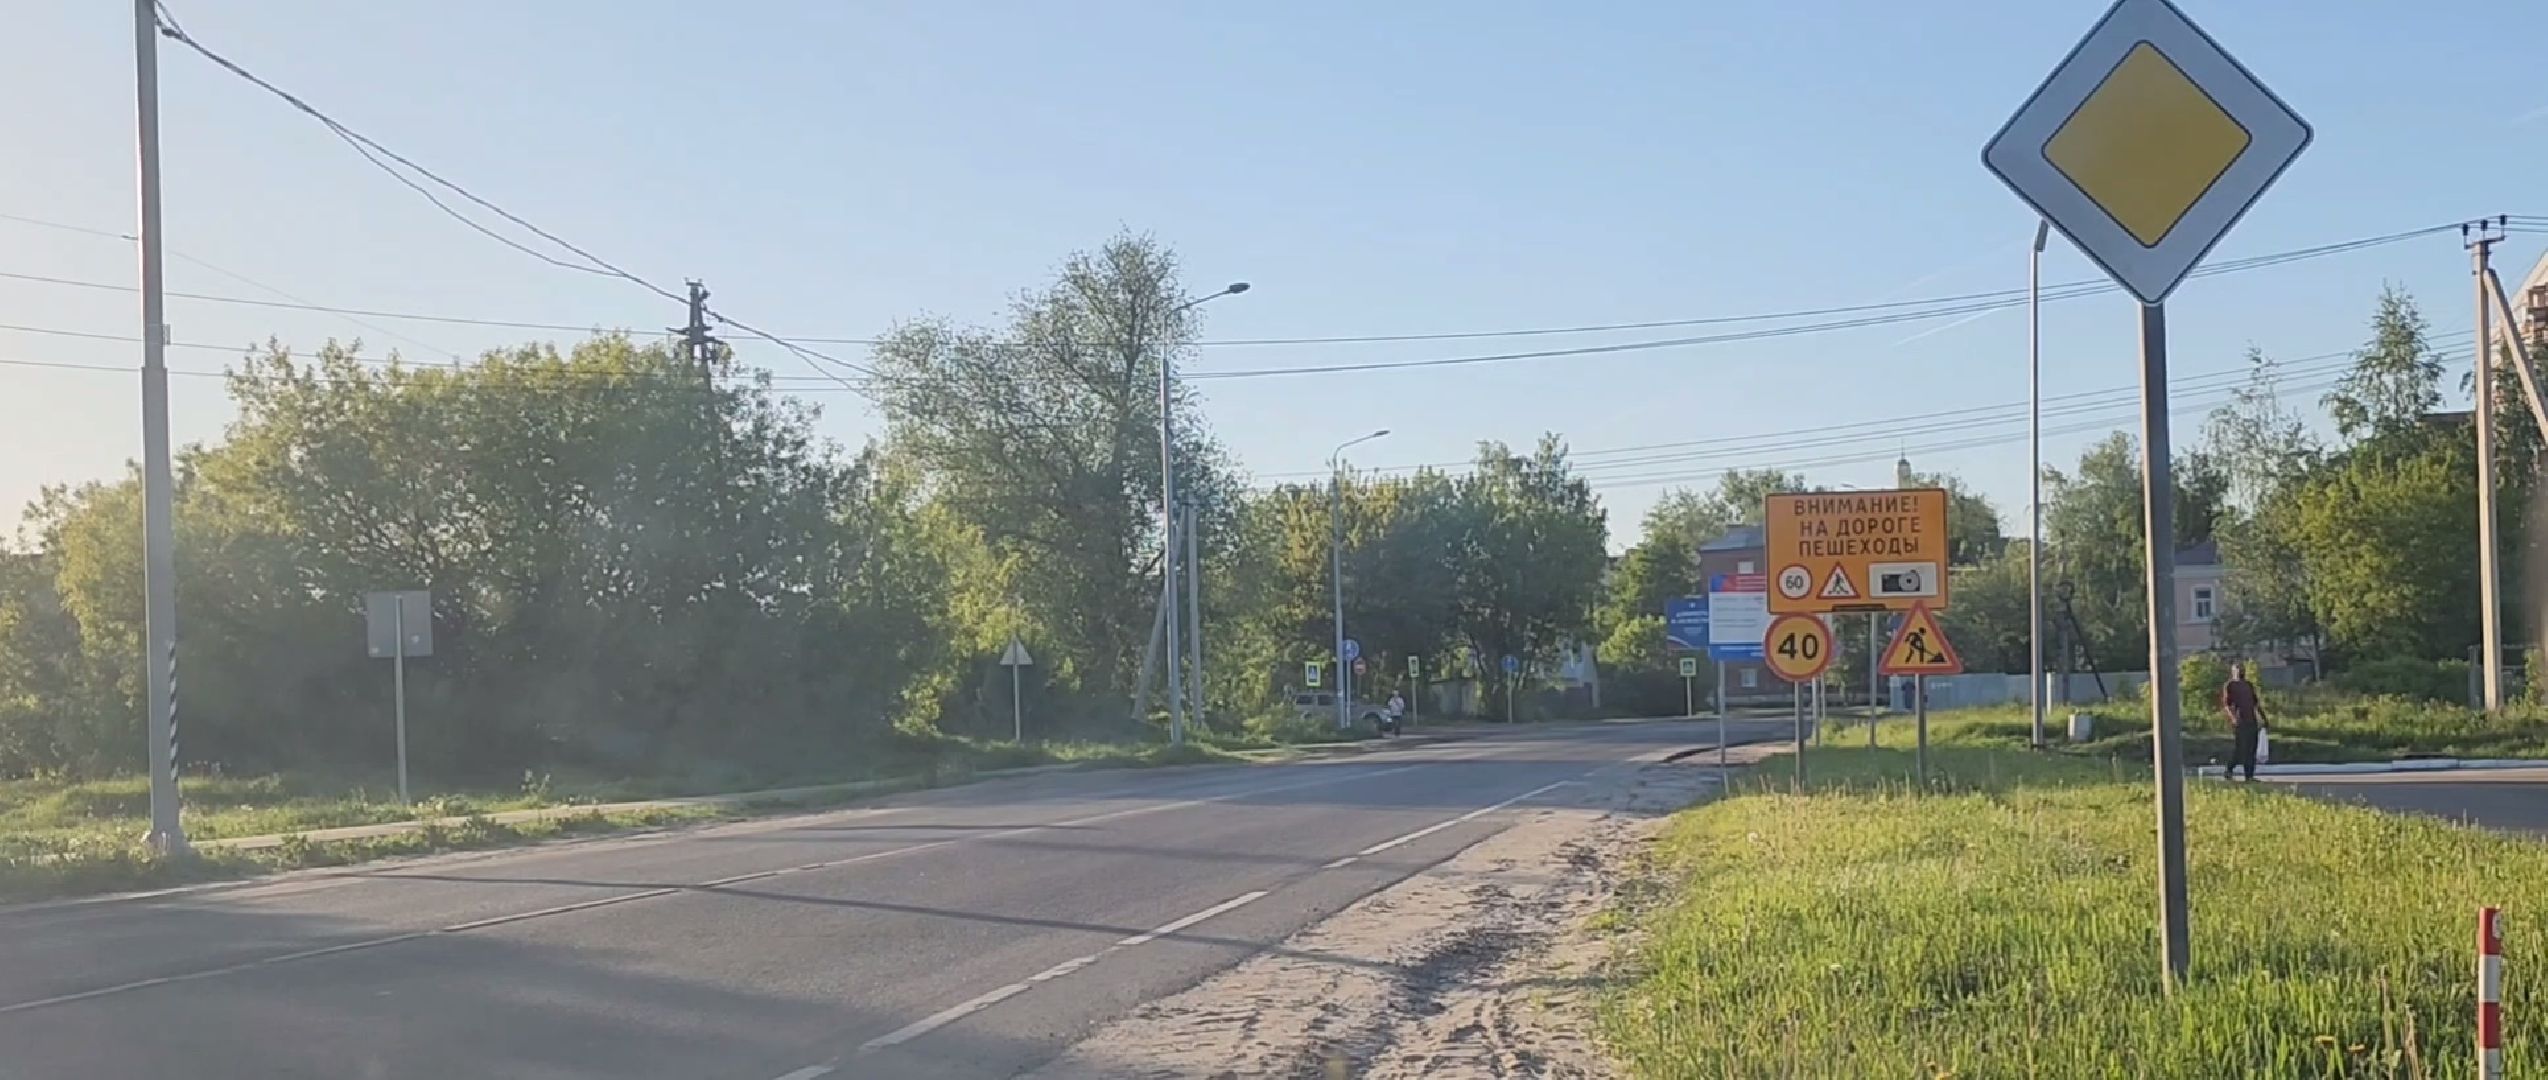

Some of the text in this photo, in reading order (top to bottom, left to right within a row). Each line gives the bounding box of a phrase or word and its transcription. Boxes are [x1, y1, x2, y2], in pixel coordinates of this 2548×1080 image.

[1794, 495, 1919, 516] ВНИМАНИЕ!
[1800, 516, 1921, 537] НА ДОРОГЕ
[1799, 537, 1919, 557] ПЕШЕХОДЫ
[1785, 575, 1804, 590] 60
[1778, 633, 1818, 660] 40
